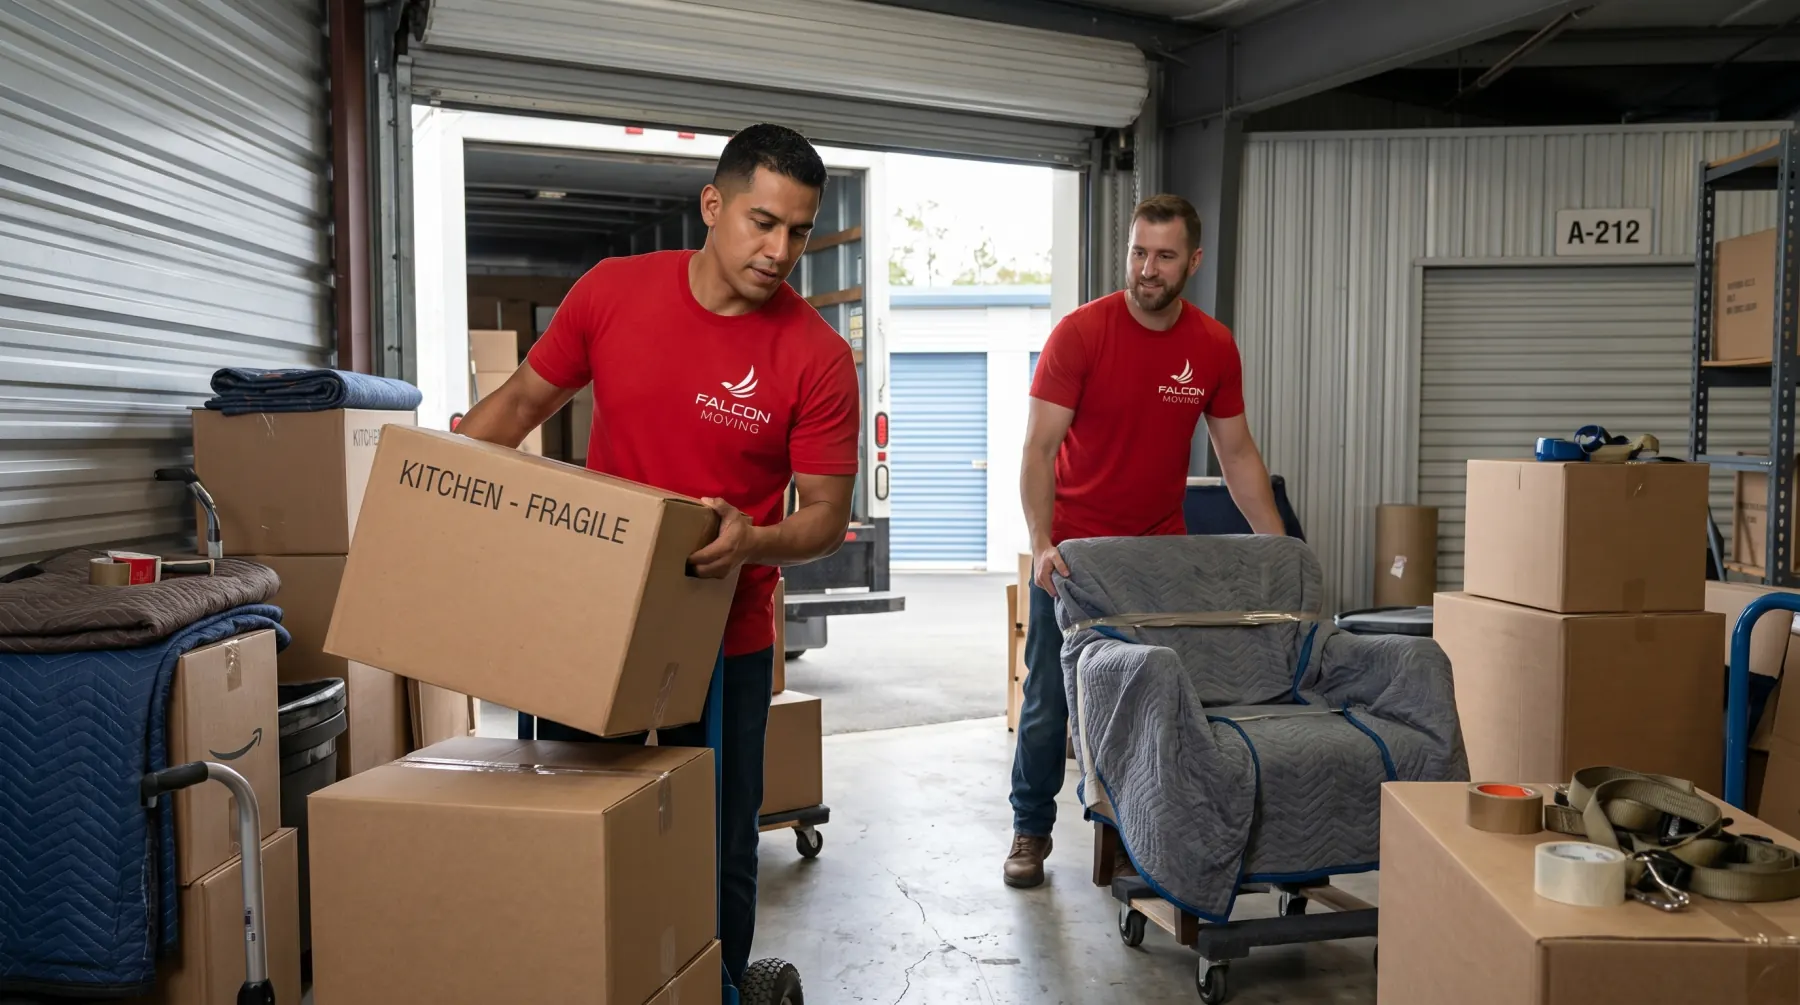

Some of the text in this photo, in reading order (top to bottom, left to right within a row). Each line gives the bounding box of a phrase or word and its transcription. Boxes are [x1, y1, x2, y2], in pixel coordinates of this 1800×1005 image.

[1567, 220, 1640, 244] A-212
[1158, 385, 1205, 396] FALCON
[1162, 395, 1200, 405] MOVING
[695, 393, 771, 424] FALCON
[700, 409, 760, 434] MOVING
[353, 428, 380, 446] KITCHE
[399, 459, 504, 510] KITCHEN
[525, 493, 630, 544] FRAGILE
